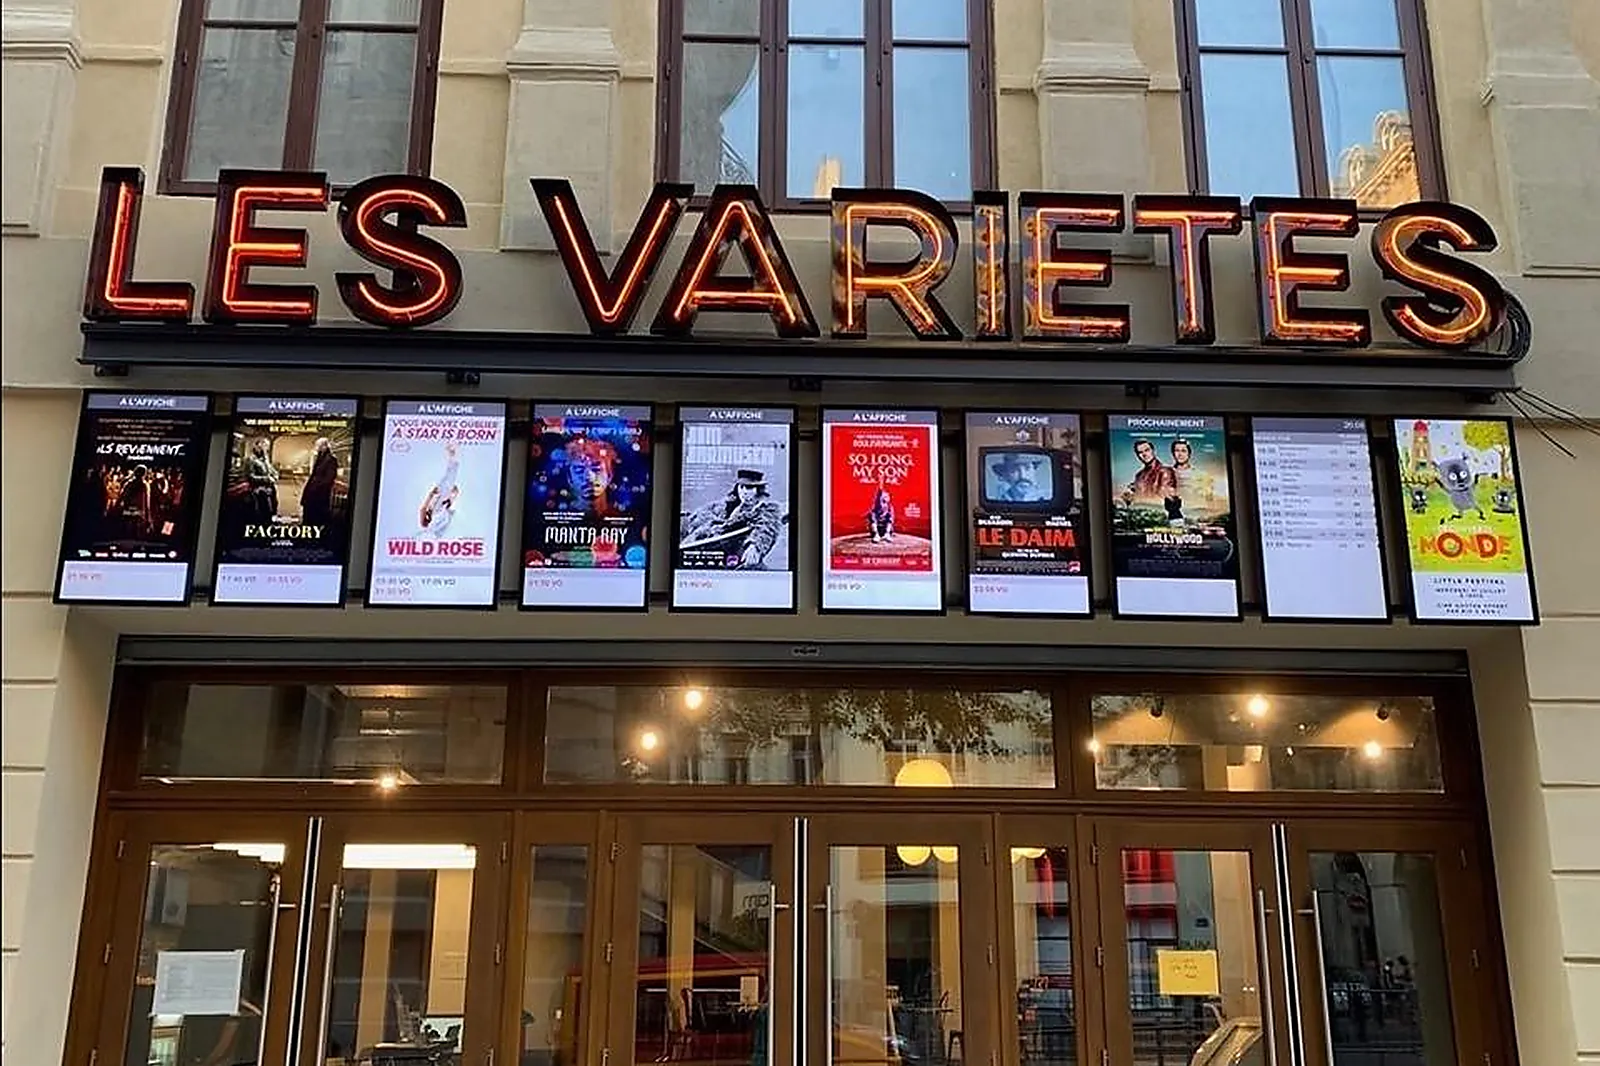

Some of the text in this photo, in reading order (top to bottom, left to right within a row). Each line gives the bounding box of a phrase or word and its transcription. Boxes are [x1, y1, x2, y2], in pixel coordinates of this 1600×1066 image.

[82, 164, 1504, 350] LES VARIETES
[1127, 417, 1206, 428] PROCHAINEMENT
[391, 428, 498, 441] A STAR IS BORN
[847, 453, 868, 466] SO
[852, 465, 908, 478] MY SON
[243, 524, 326, 539] FACTORY
[544, 525, 629, 546] MANTA RAY
[978, 526, 1077, 548] LE DAIM
[1145, 532, 1203, 545] HOLLYWOOD
[387, 540, 484, 557] WILD ROSE
[1419, 532, 1512, 558] MONDE
